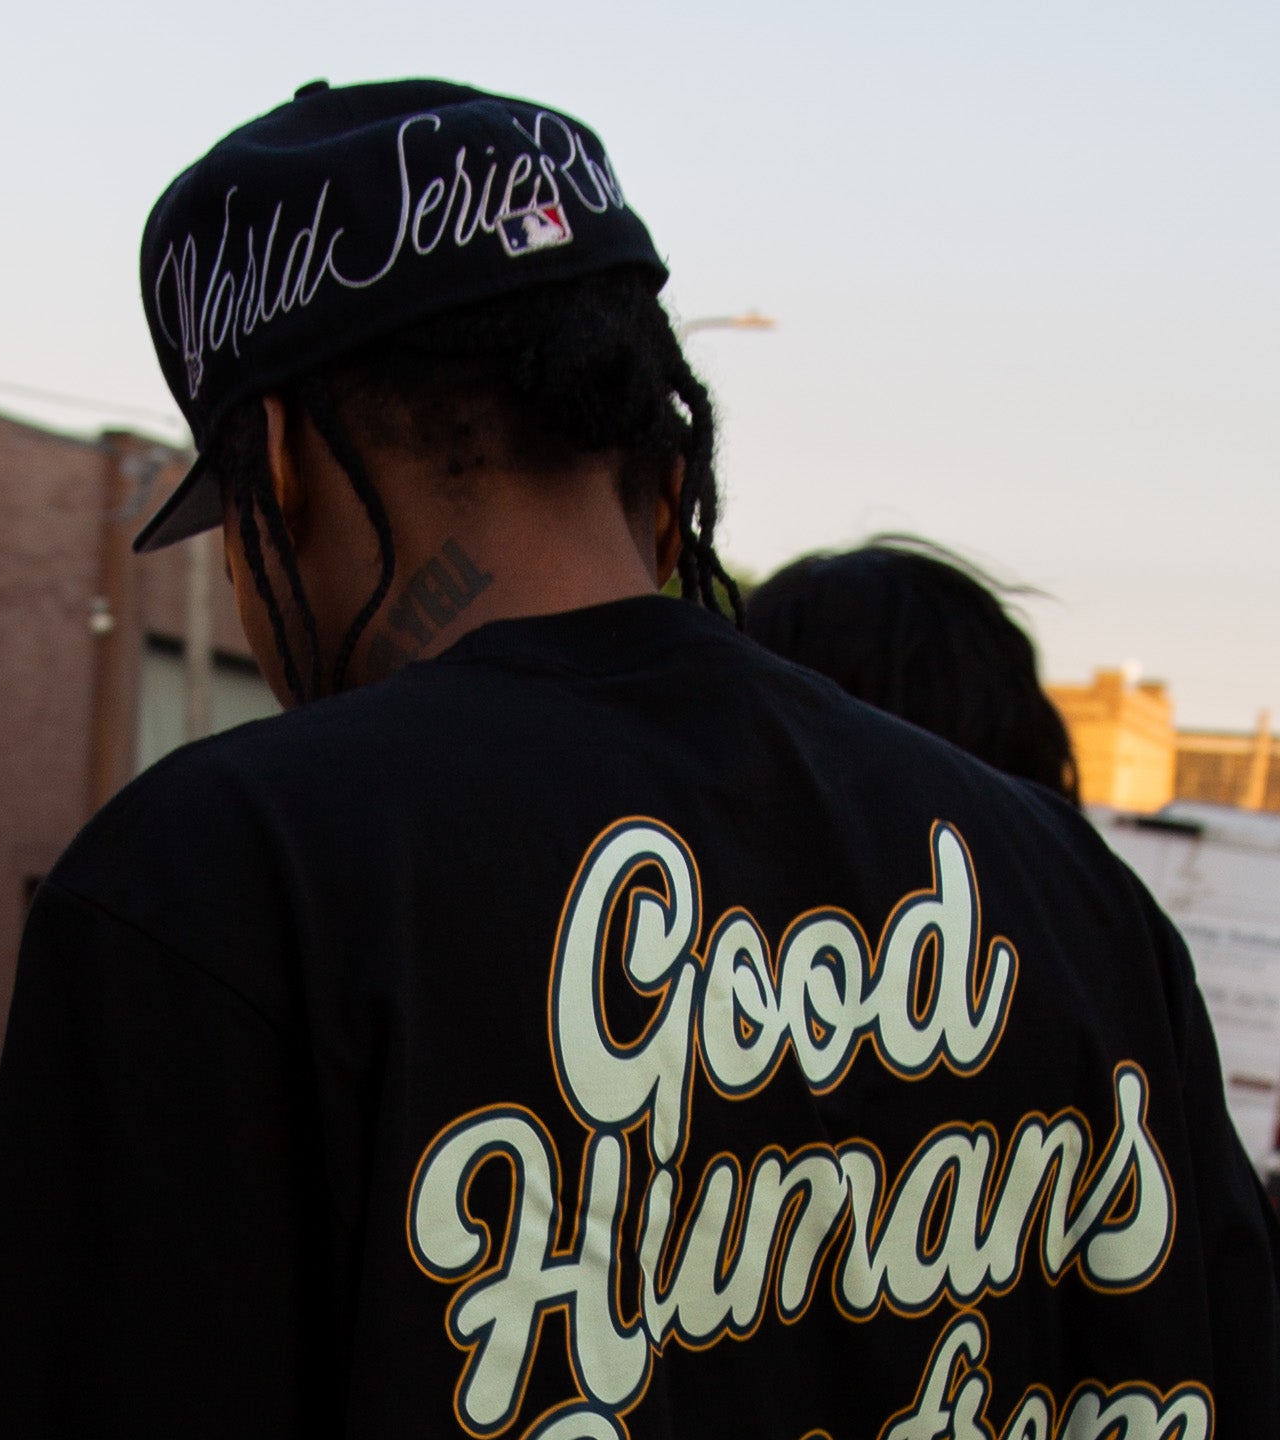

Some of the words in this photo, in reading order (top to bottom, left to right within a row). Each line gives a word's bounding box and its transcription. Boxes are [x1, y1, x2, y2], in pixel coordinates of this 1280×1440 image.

[155, 179, 342, 400] World
[328, 114, 559, 287] Series
[551, 816, 1017, 1162] Good
[409, 1063, 1176, 1438] Humans
